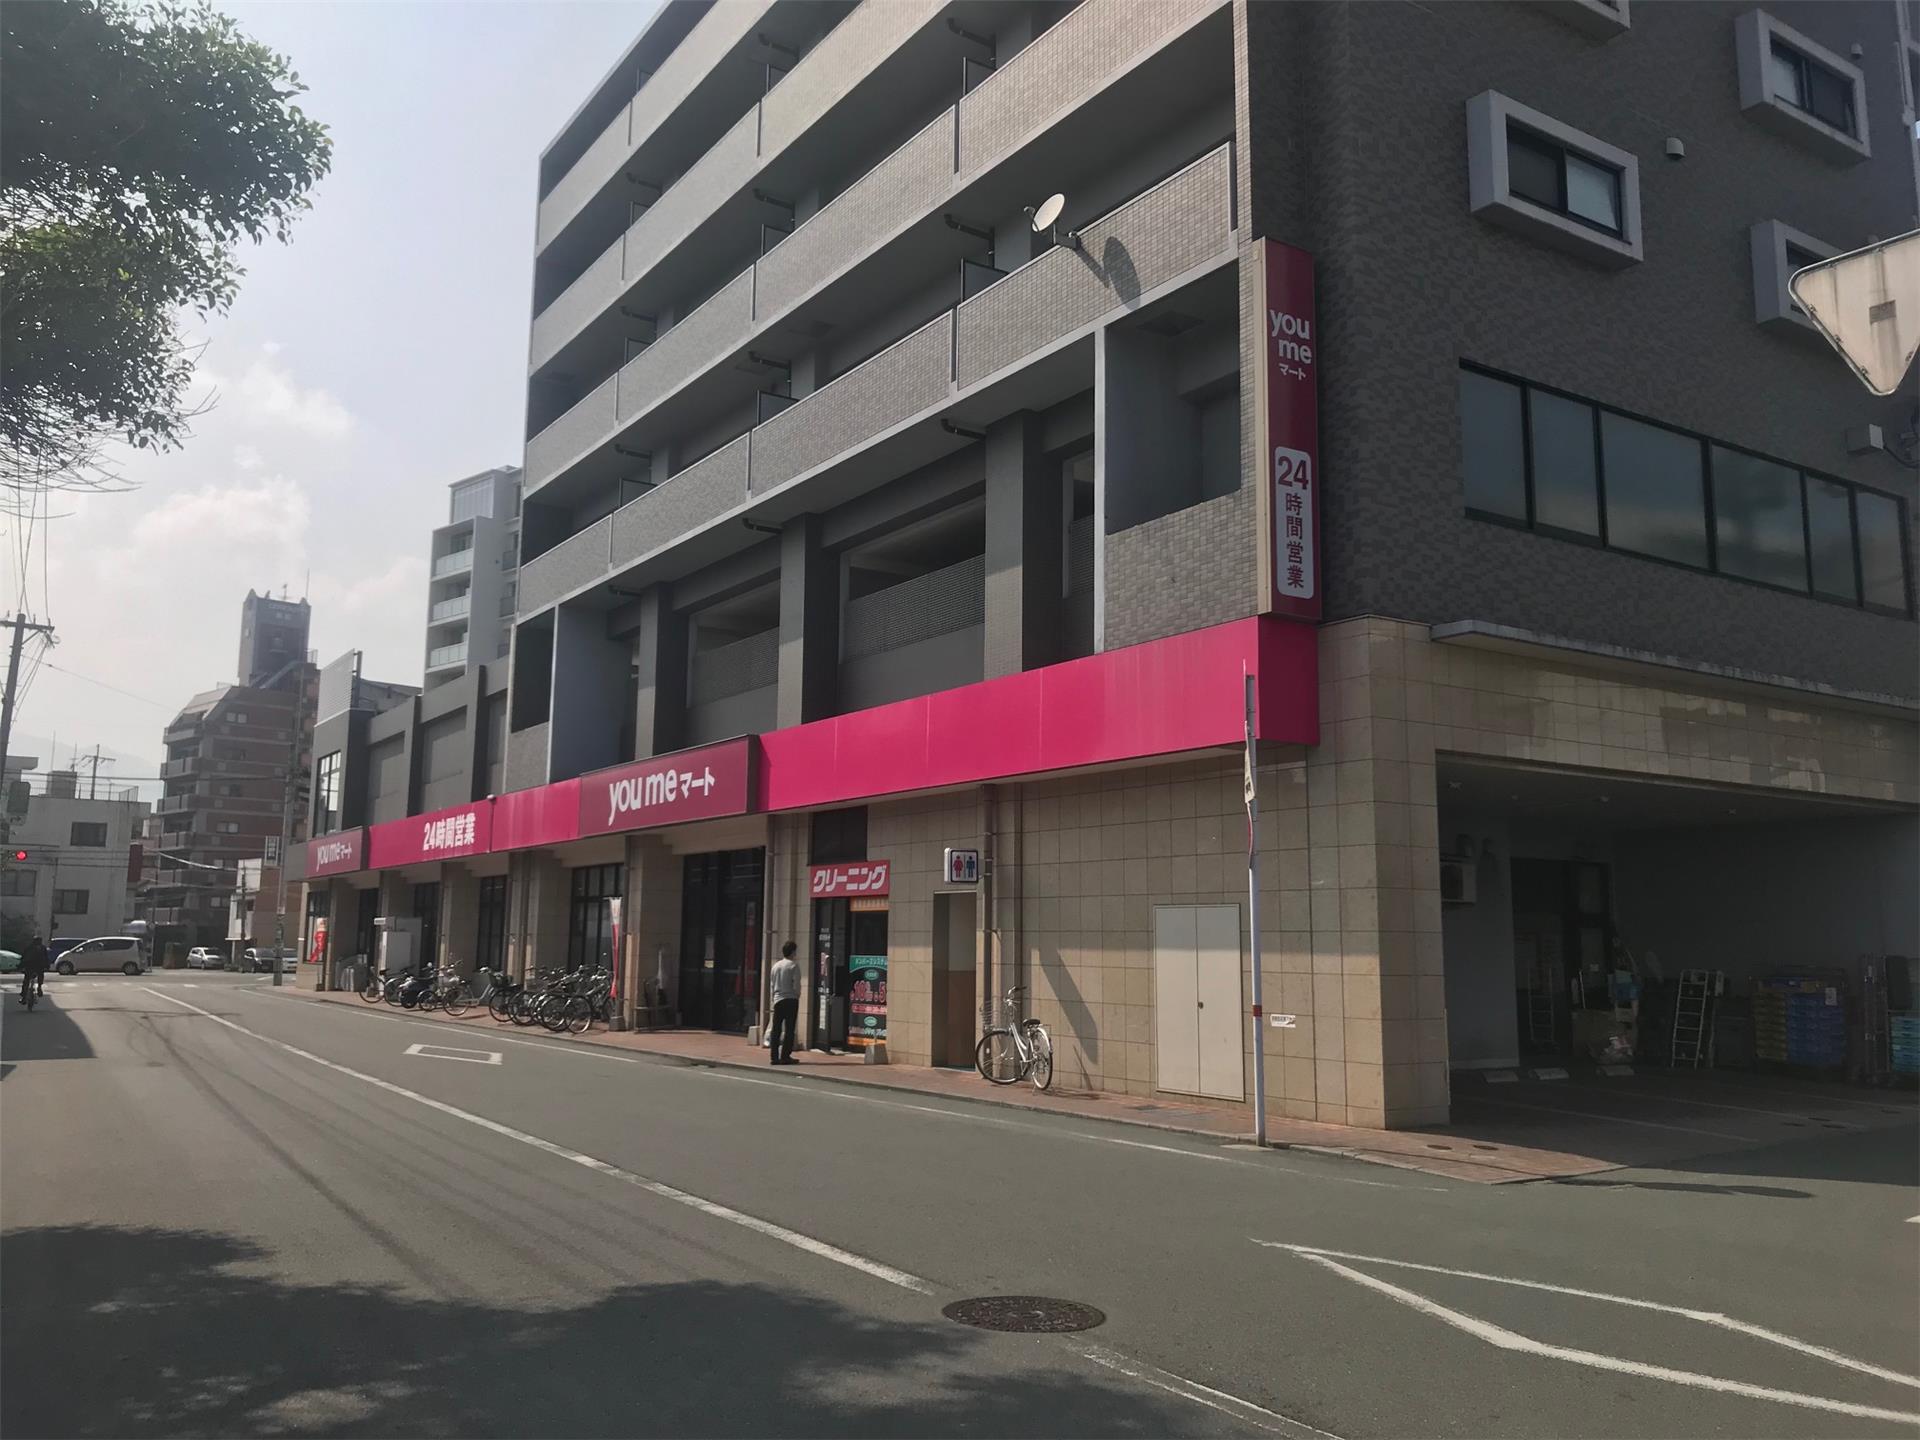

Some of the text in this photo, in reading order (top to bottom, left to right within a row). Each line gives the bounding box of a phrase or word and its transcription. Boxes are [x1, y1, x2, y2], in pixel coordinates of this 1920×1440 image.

[1270, 309, 1310, 339] you
[1278, 339, 1312, 364] me
[1279, 362, 1306, 381] マート
[423, 812, 476, 851] 24時間営業
[813, 864, 887, 893] クリーニング
